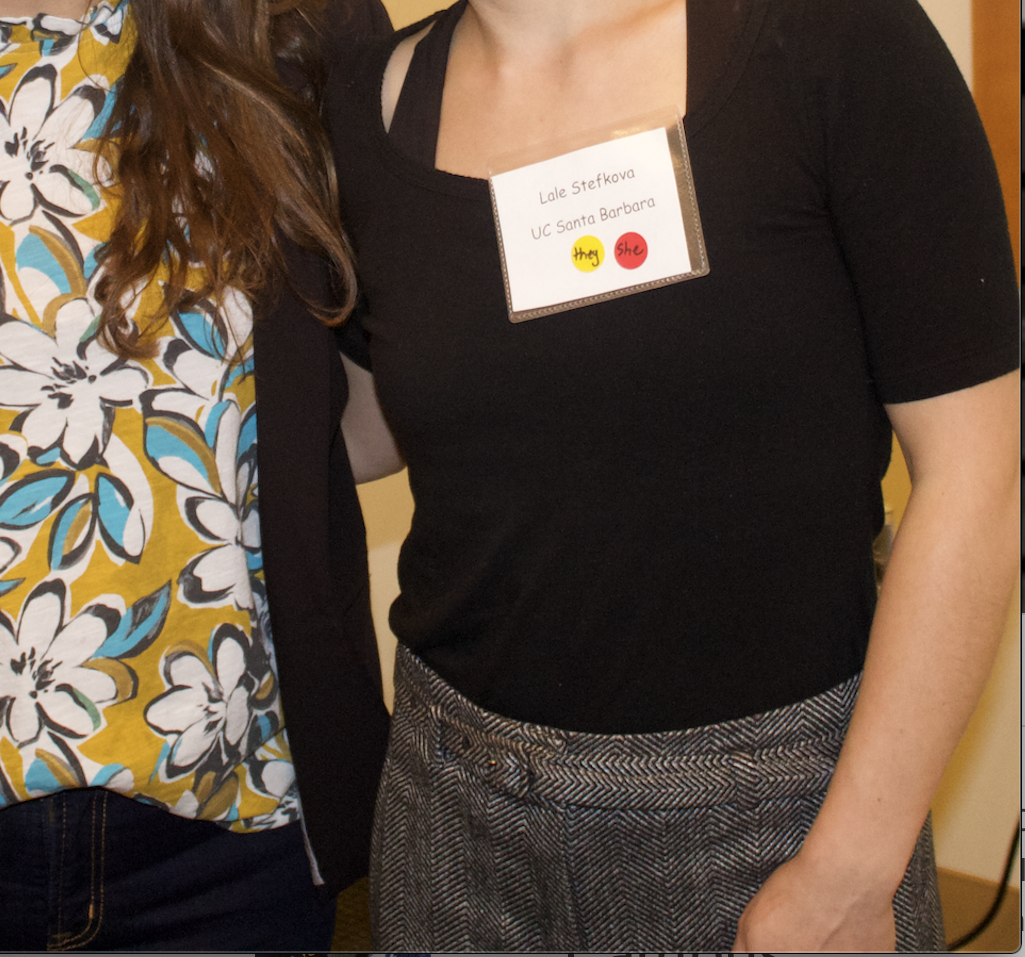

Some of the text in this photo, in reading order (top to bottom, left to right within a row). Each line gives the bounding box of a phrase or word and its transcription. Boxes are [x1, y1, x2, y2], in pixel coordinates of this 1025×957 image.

[539, 168, 635, 205] Lale Stefkova
[530, 197, 656, 241] UC Santa Barbara
[573, 247, 600, 267] they
